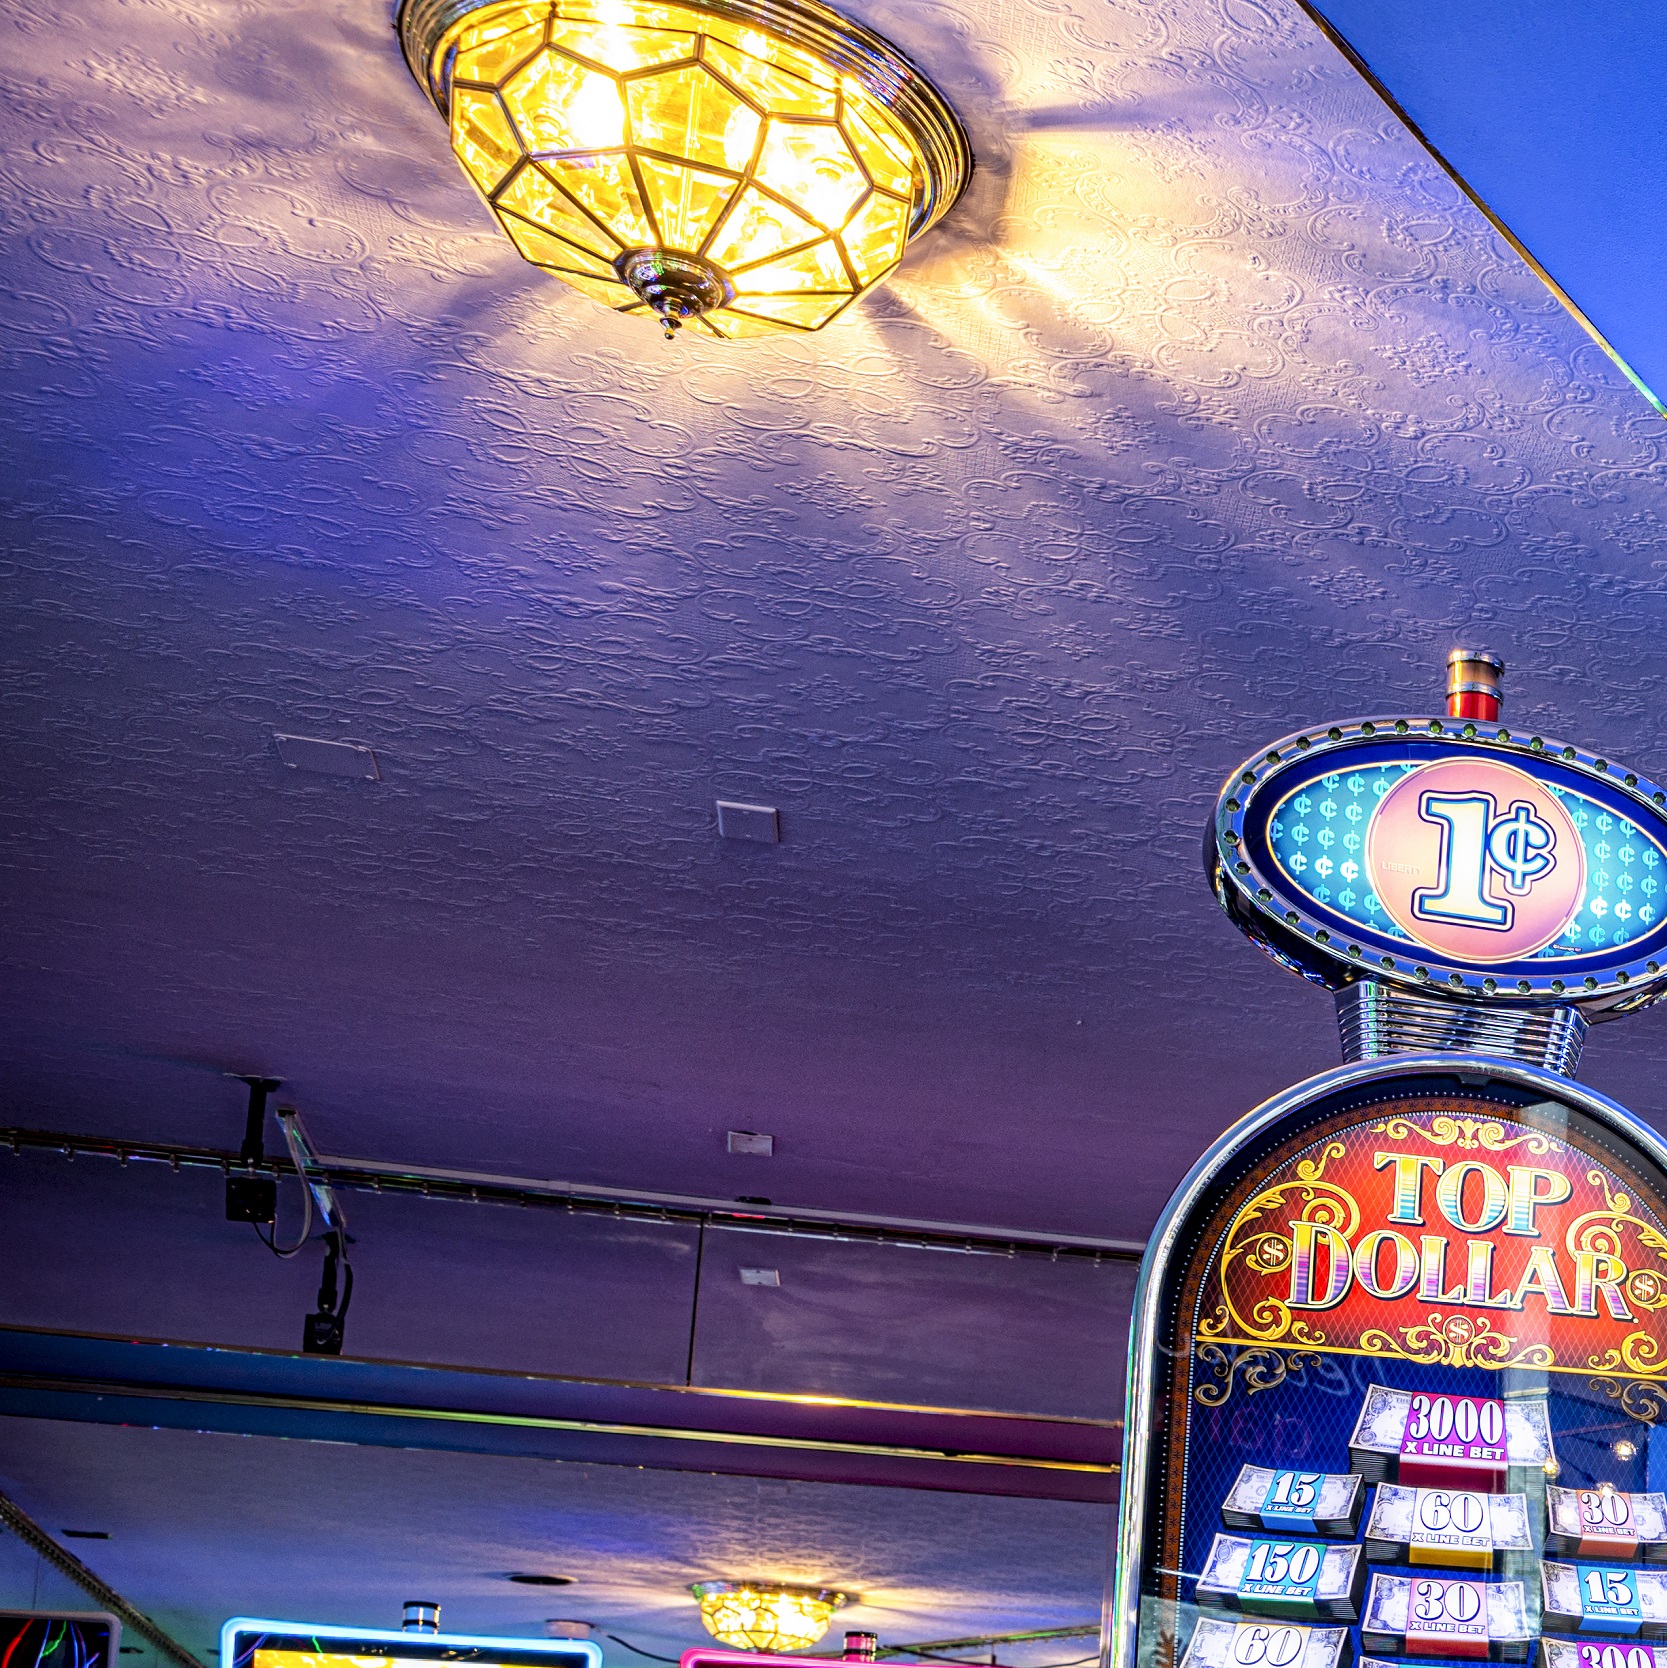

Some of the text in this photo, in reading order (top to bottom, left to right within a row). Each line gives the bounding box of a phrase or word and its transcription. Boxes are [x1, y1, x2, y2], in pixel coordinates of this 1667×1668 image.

[1381, 861, 1423, 876] LIBERTY
[1412, 789, 1557, 931] 1¢
[1373, 1151, 1572, 1236] TOP
[1408, 1394, 1504, 1445] 3000
[1404, 1441, 1504, 1461] X LINE BET
[1270, 1472, 1321, 1506] 15
[1420, 1491, 1484, 1532] 60
[1246, 1542, 1320, 1584] 150
[1241, 1584, 1312, 1596] X LINE BET
[1414, 1580, 1481, 1622] 30
